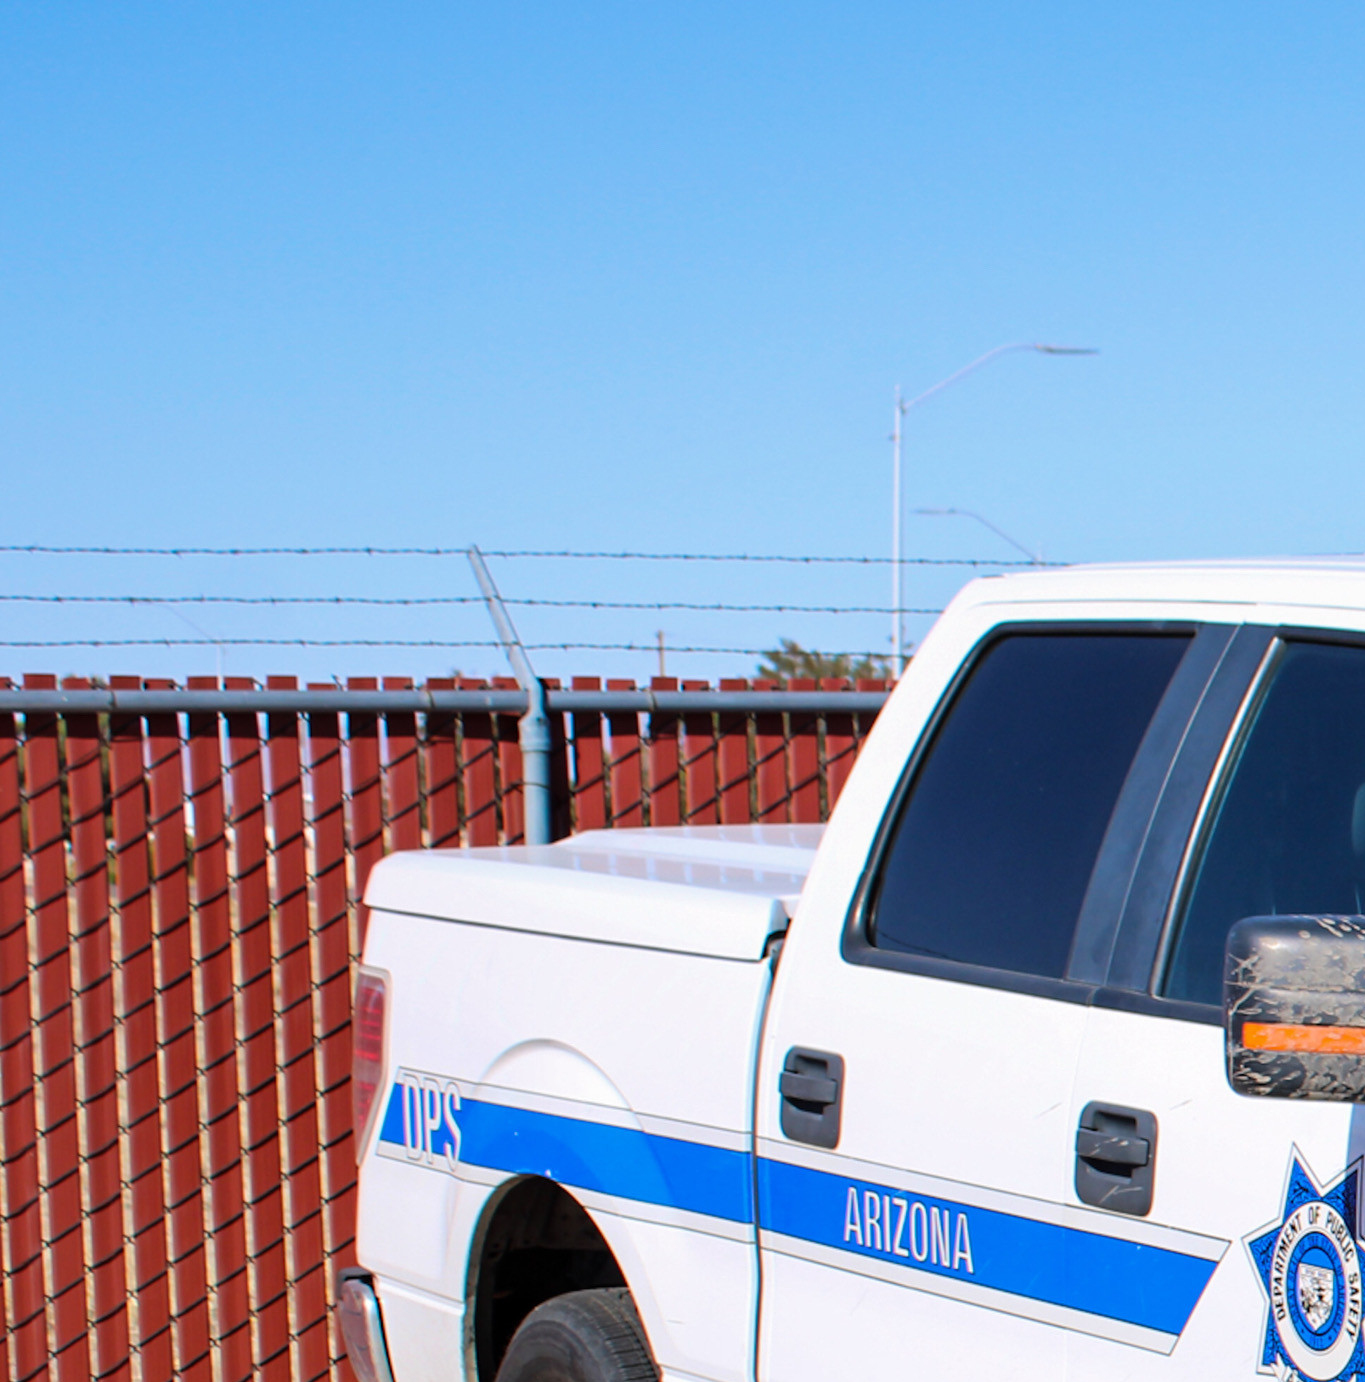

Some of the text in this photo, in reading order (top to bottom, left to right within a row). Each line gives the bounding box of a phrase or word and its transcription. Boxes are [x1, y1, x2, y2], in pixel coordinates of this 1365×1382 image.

[401, 1073, 461, 1172] DPS
[843, 1186, 974, 1274] ARIZONA
[1273, 1205, 1360, 1343] DEPARTMENT OF PUBLIC SAFETY
